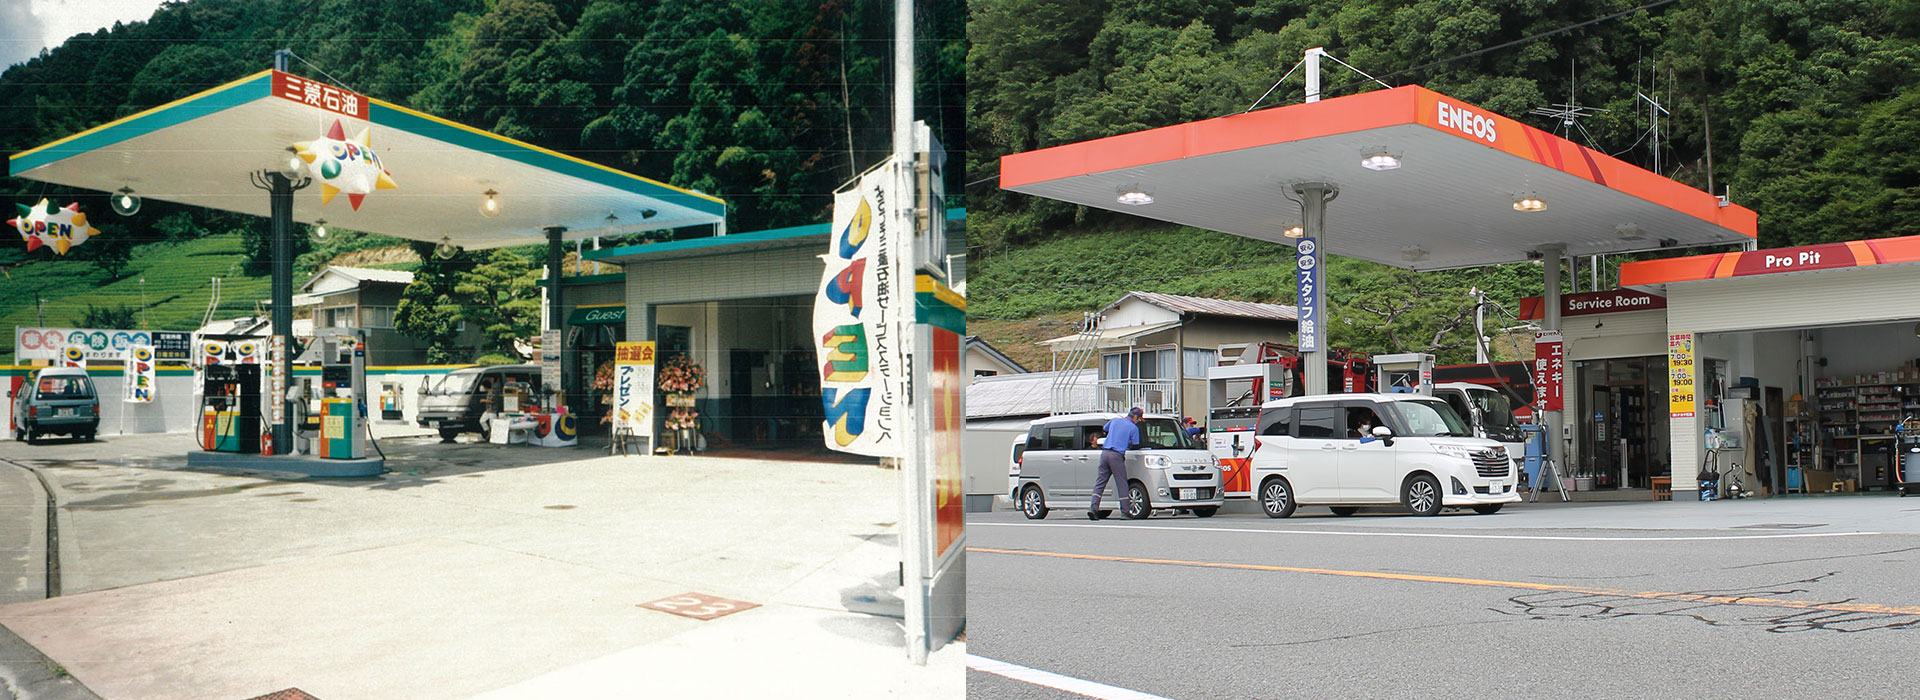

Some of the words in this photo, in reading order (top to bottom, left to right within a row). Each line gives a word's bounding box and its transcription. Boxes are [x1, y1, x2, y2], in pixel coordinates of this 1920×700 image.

[285, 76, 358, 115] 三菱石油
[1438, 101, 1497, 143] ENEOS
[329, 142, 382, 170] OPEN
[22, 219, 74, 240] OPEN
[1300, 244, 1314, 252] 安心
[1300, 258, 1314, 267] 安全
[1765, 254, 1793, 268] Pro
[1799, 251, 1821, 265] Pit
[1301, 271, 1315, 349] スタッフ給油
[1569, 298, 1612, 310] Service
[1615, 295, 1650, 307] Room
[586, 309, 625, 321] Guest
[70, 333, 106, 348] 保険
[617, 345, 653, 361] 抽選会
[135, 348, 152, 401] OPEN
[1551, 345, 1562, 398] エネキー
[1536, 359, 1548, 409] 使えます
[1672, 394, 1694, 402] 定休日
